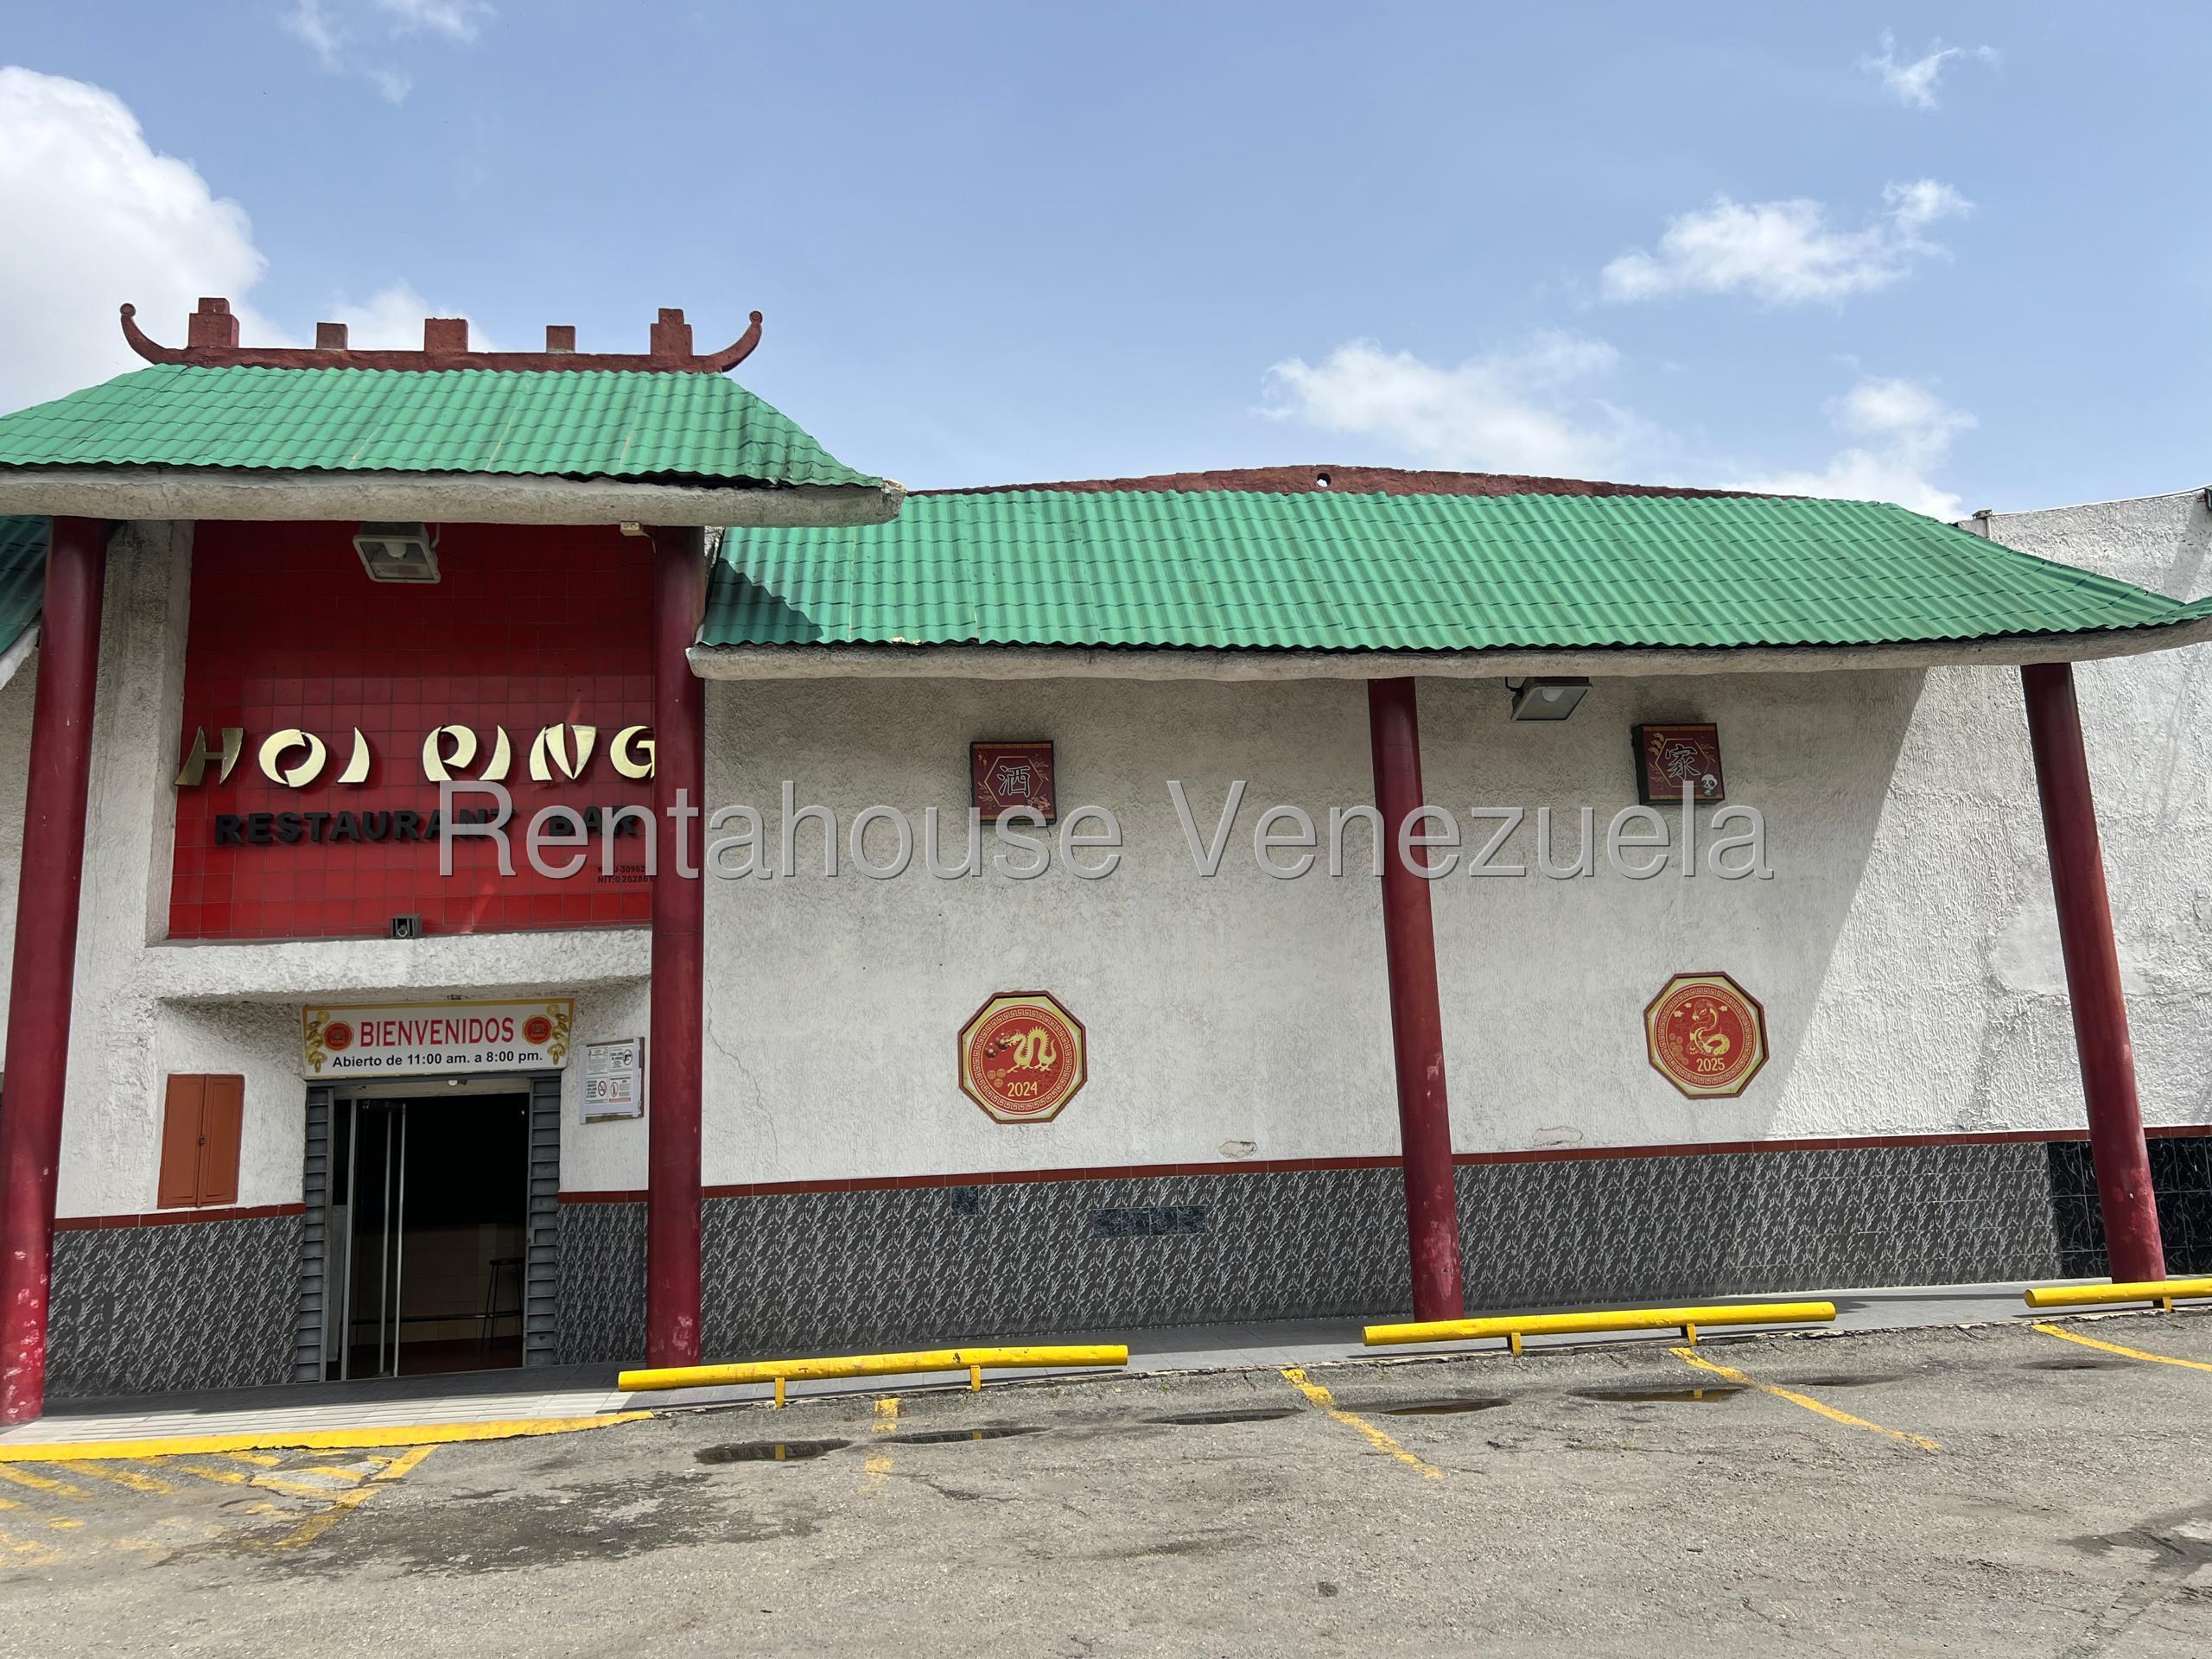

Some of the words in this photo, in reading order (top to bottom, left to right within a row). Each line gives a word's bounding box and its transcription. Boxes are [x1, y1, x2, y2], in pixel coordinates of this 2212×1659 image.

[174, 726, 371, 788] HOI
[423, 723, 655, 781] PING
[1664, 743, 1701, 781] 家
[548, 804, 637, 838] BAR
[359, 1016, 515, 1047] BIENVENIDOS
[332, 1055, 382, 1068] Abierto
[385, 1054, 403, 1066] de
[407, 1052, 442, 1065] 11:00
[446, 1053, 470, 1064] am.
[474, 1053, 482, 1063] a
[486, 1051, 514, 1063] 8:00
[518, 1052, 543, 1064] pm.
[1696, 1058, 1726, 1072] 2025
[1007, 1081, 1038, 1097] 2024
